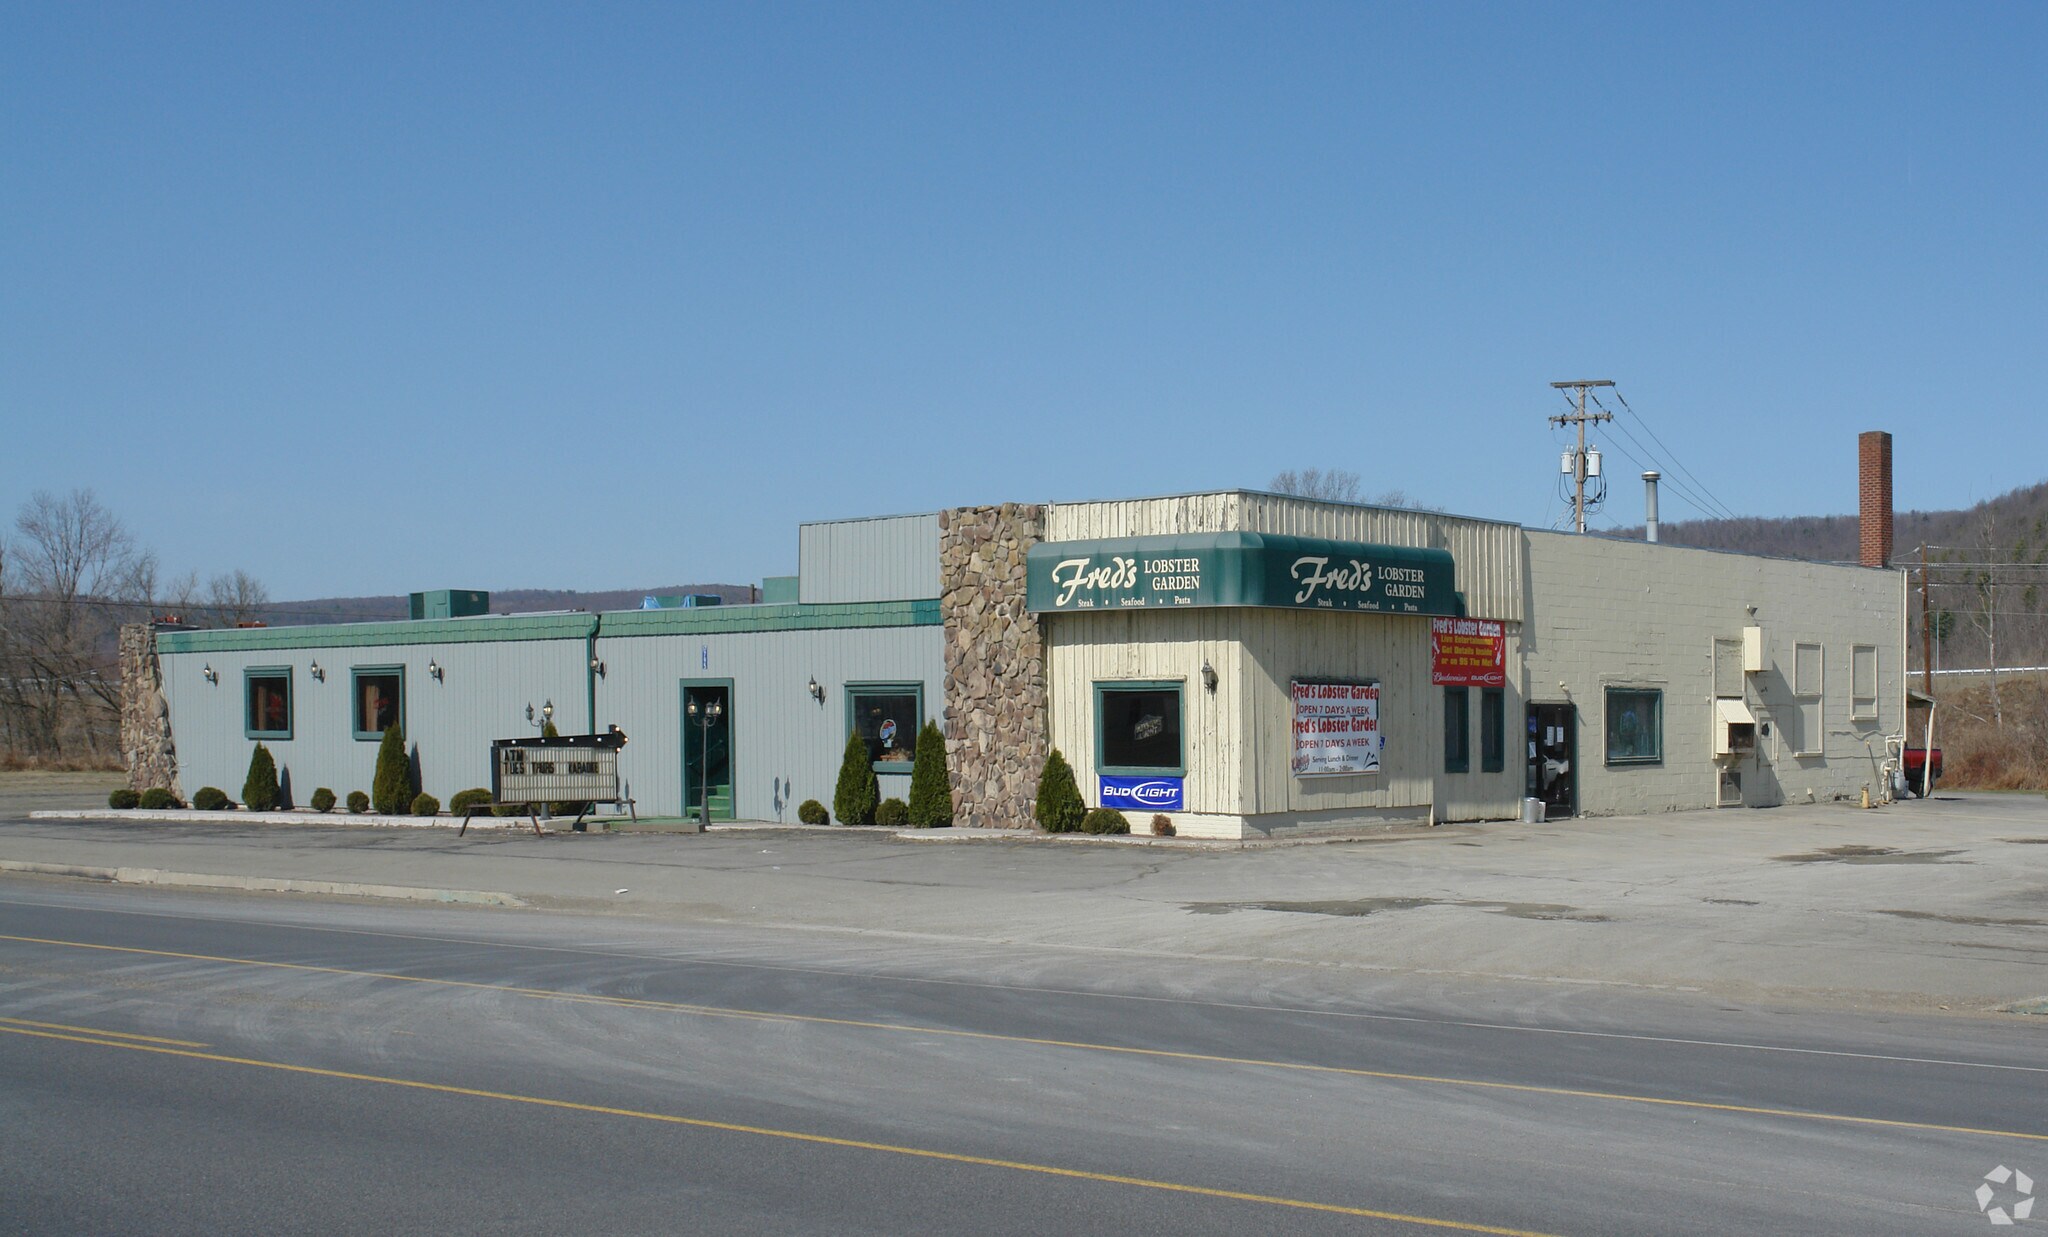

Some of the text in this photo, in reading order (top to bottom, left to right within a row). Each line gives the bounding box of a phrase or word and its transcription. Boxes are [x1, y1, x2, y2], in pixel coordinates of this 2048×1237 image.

[1052, 557, 1199, 606] Fred's LOBSTER
[1152, 576, 1200, 590] GARDEN
[1291, 557, 1424, 603] Fred's LOBSTER
[1385, 584, 1425, 598] GARDEN
[1078, 596, 1191, 607] Steak Seafood Pasta
[1317, 598, 1418, 611] Steak Seafood Pasta
[1433, 618, 1500, 637] Fred's Lobster Garden
[1454, 646, 1474, 655] Details
[1292, 683, 1379, 699] Fred's Lobster Garden
[1300, 705, 1370, 715] OPEN 7 DAYS A WEEK
[1318, 717, 1349, 733] Lobster
[1300, 740, 1319, 749] OPEN
[1325, 740, 1345, 748] DAYS
[1346, 739, 1351, 747] A
[1352, 738, 1370, 747] WEEK
[505, 750, 523, 761] ATM
[505, 762, 524, 774] TUES
[1137, 787, 1179, 797] LIGHT
